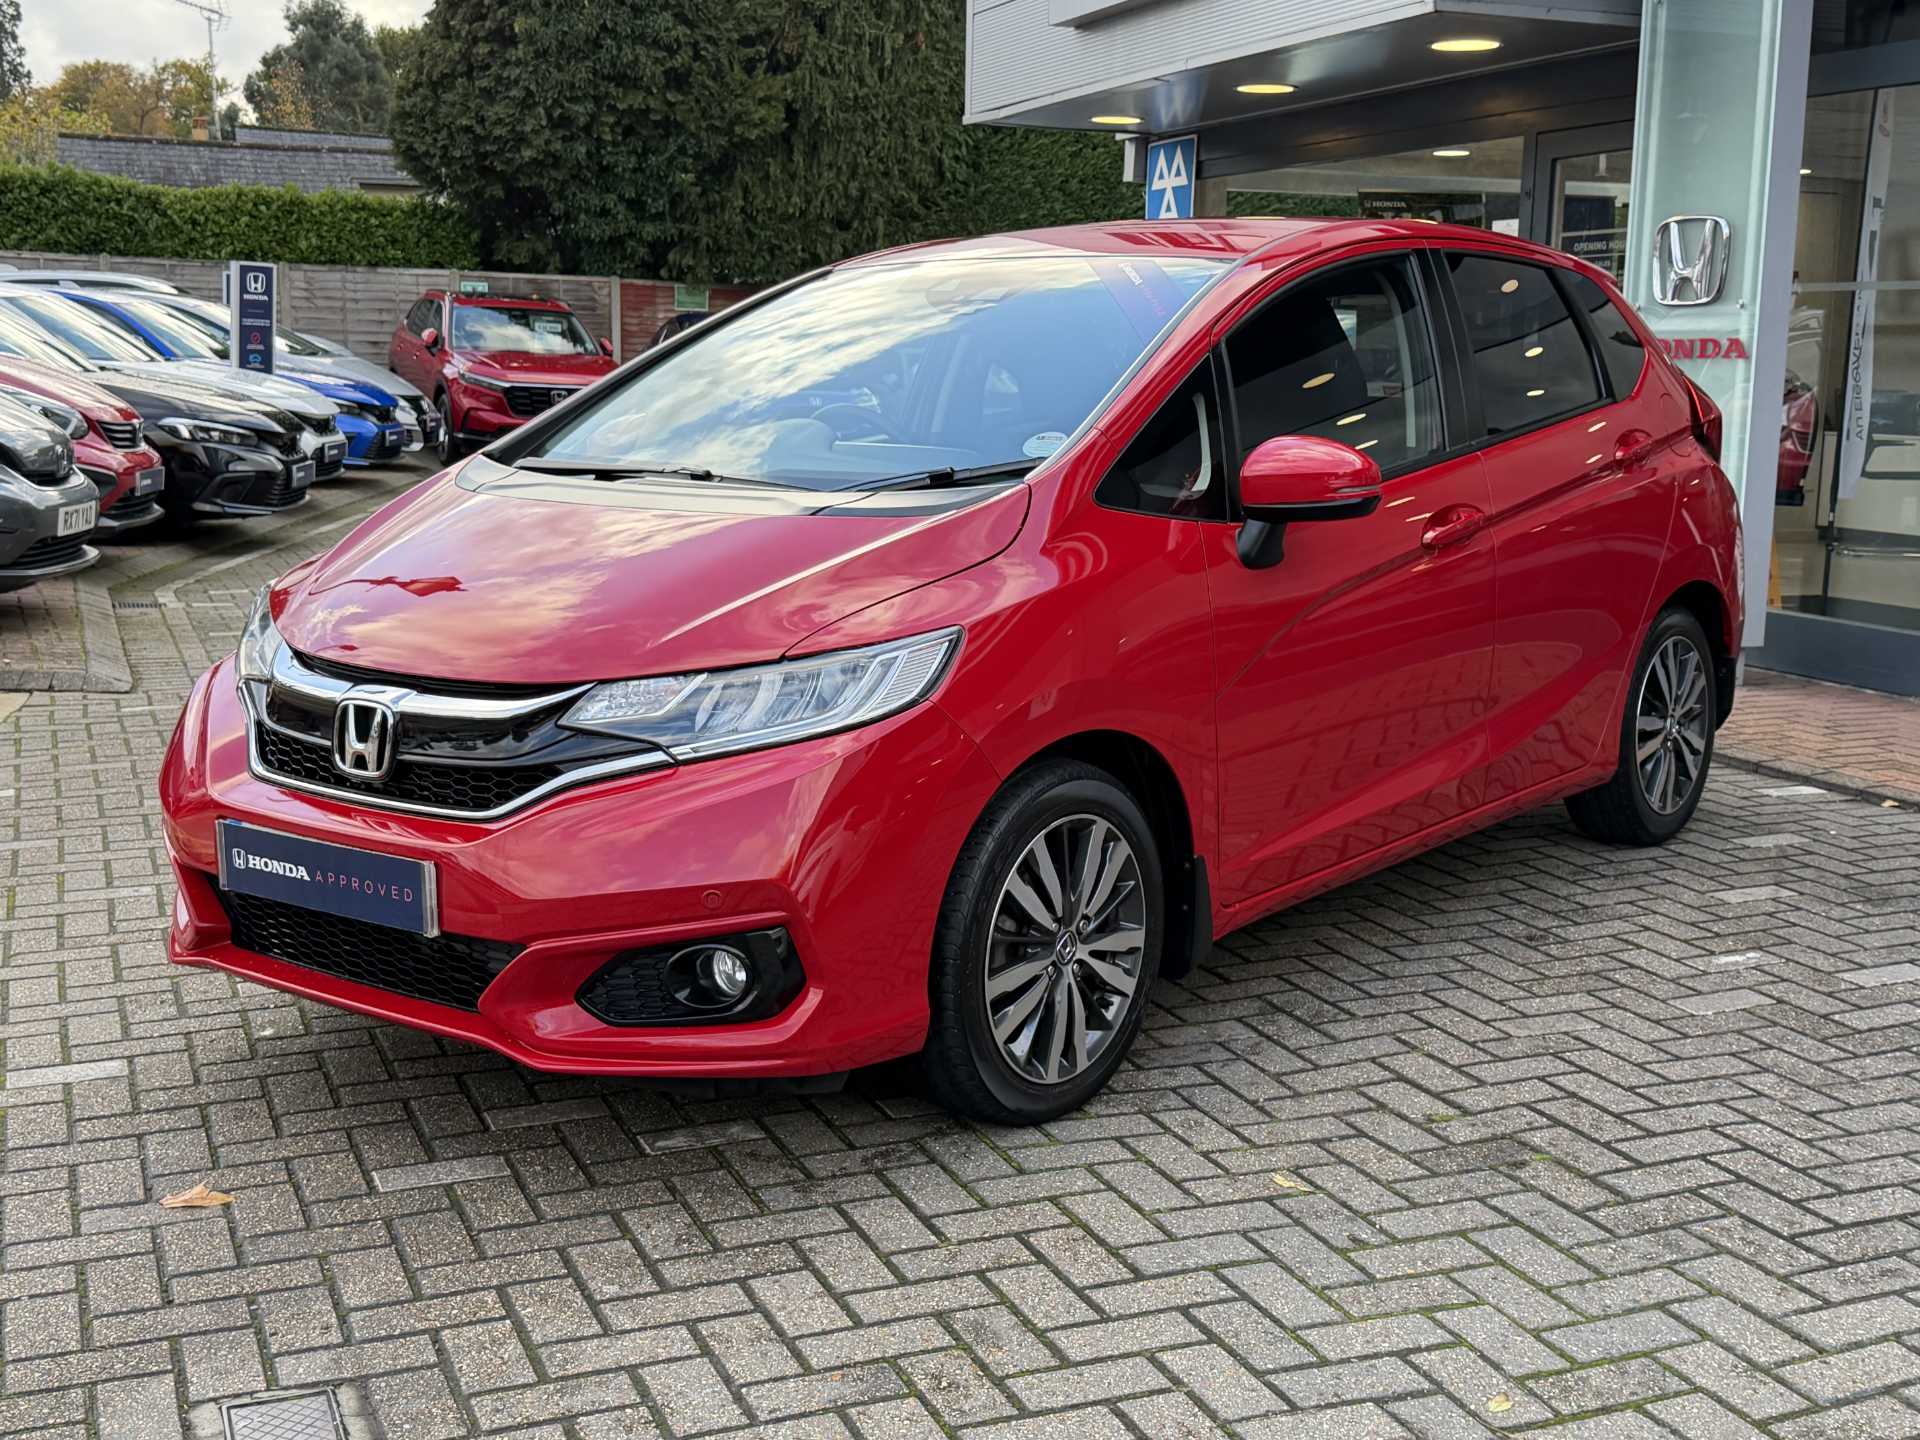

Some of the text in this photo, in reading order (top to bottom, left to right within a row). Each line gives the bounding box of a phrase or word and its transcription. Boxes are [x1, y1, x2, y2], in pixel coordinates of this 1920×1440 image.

[1574, 240, 1607, 251] OPENING
[1855, 416, 1864, 441] An
[64, 509, 80, 532] RX71
[247, 854, 413, 902] HONDA APPROVED
